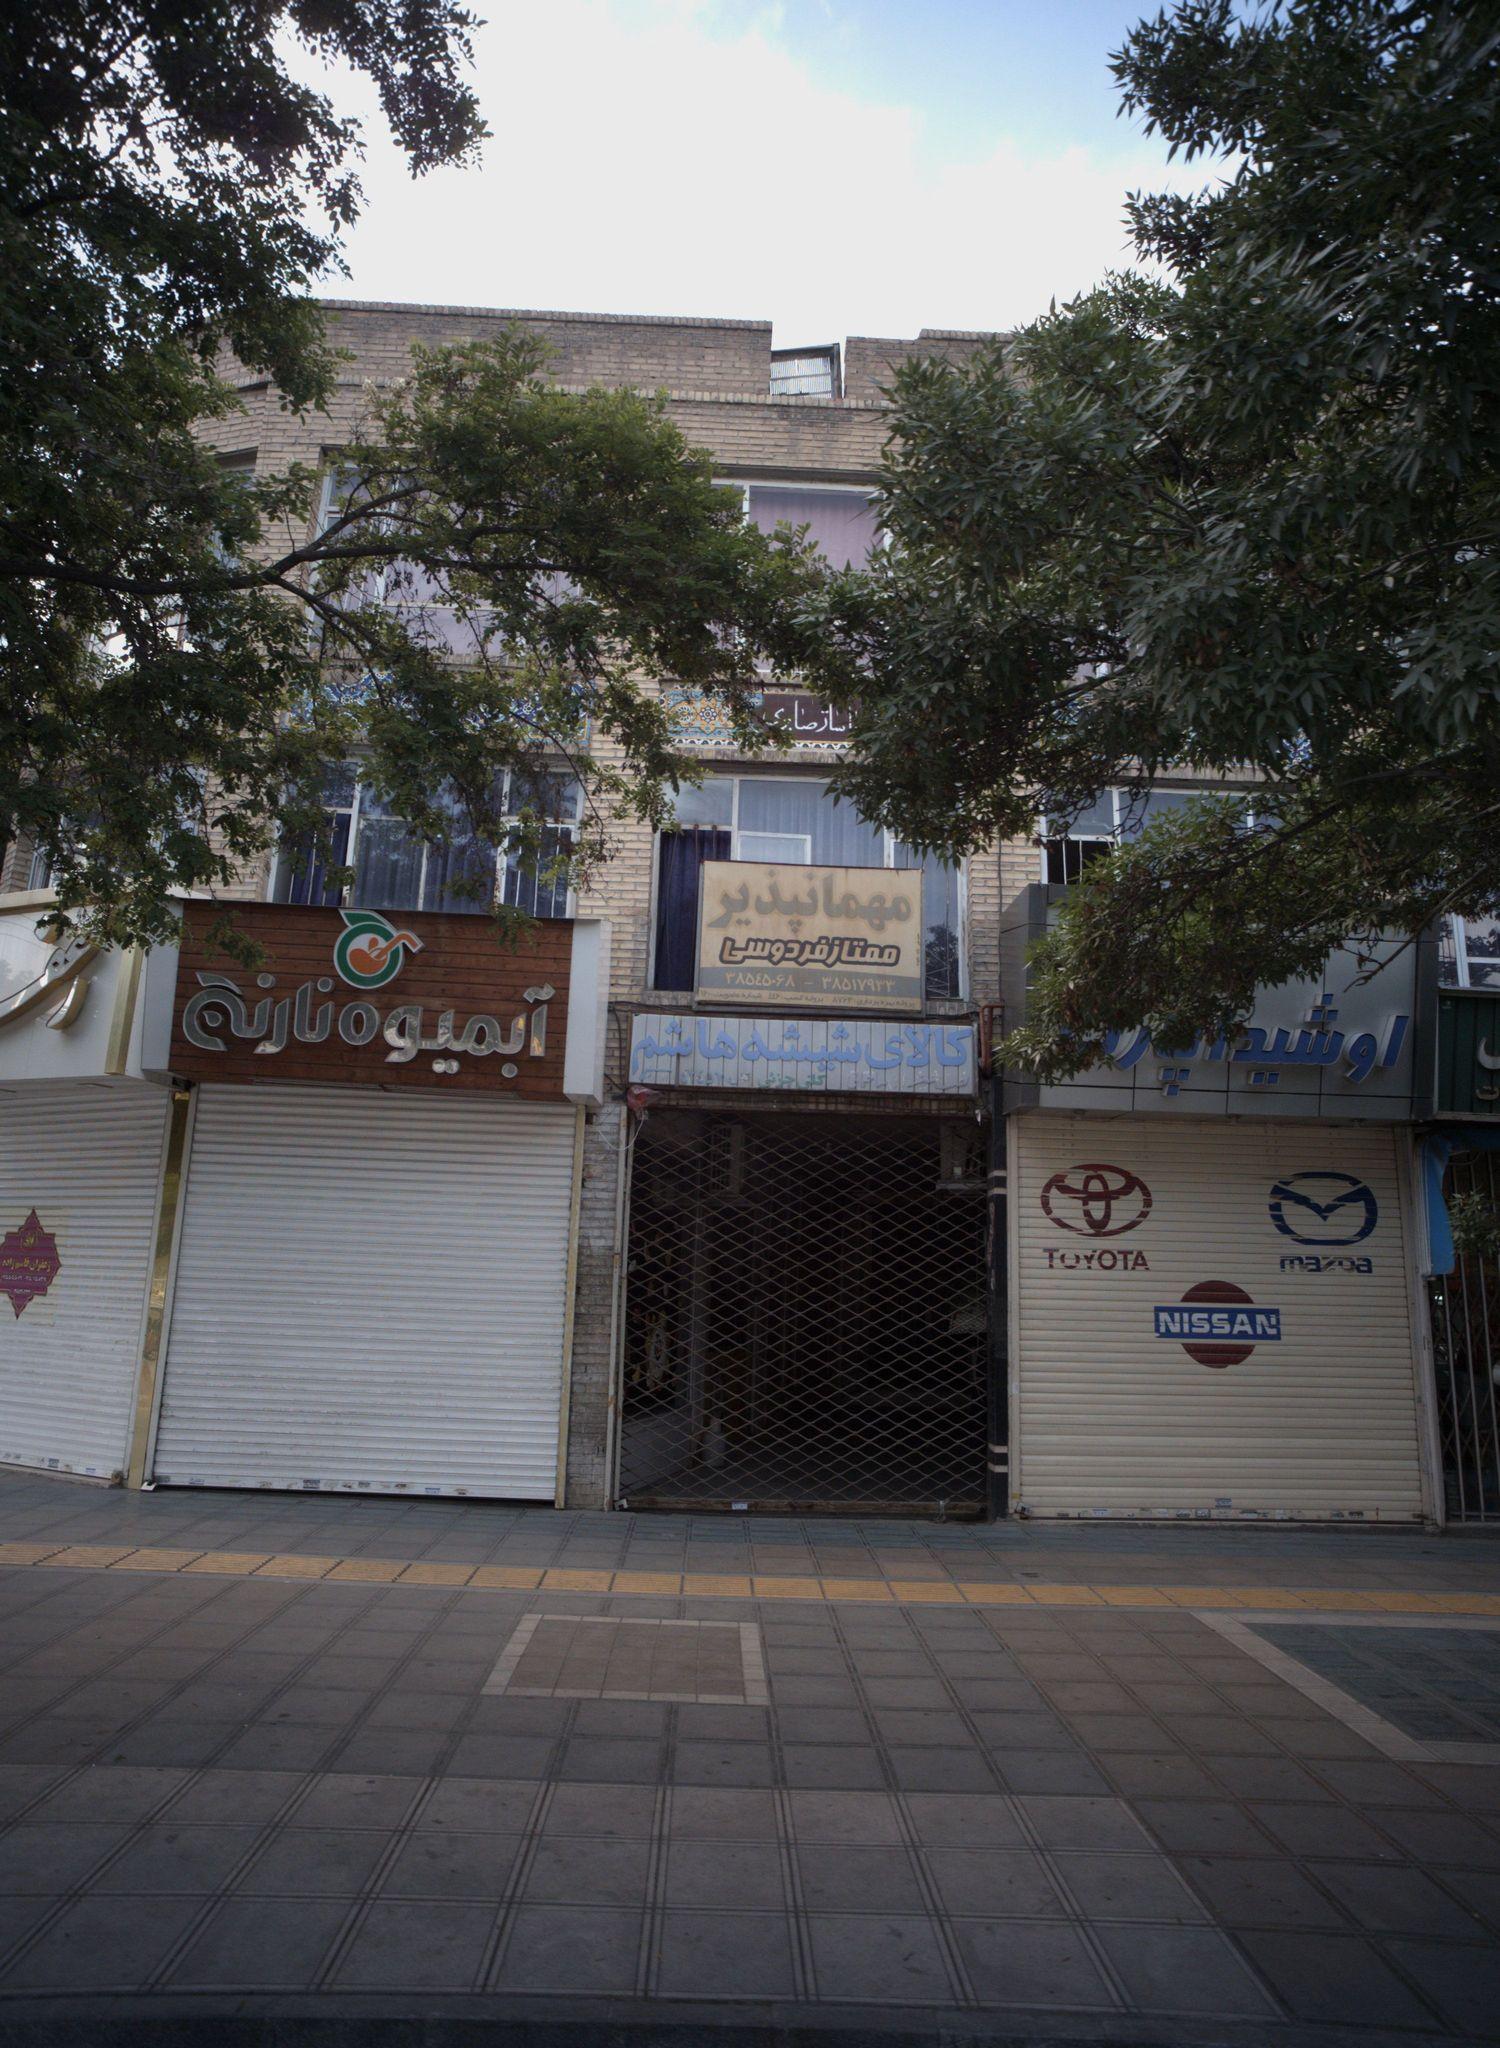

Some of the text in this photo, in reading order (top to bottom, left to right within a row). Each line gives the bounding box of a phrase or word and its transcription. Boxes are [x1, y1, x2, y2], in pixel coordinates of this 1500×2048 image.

[707, 868, 912, 934] مهمانپذیر
[182, 971, 336, 1056] نارنج
[631, 1020, 974, 1076] کالای شیشه هاشم
[1043, 1248, 1150, 1271] TOYOTA
[1158, 1312, 1279, 1336] NISSAN
